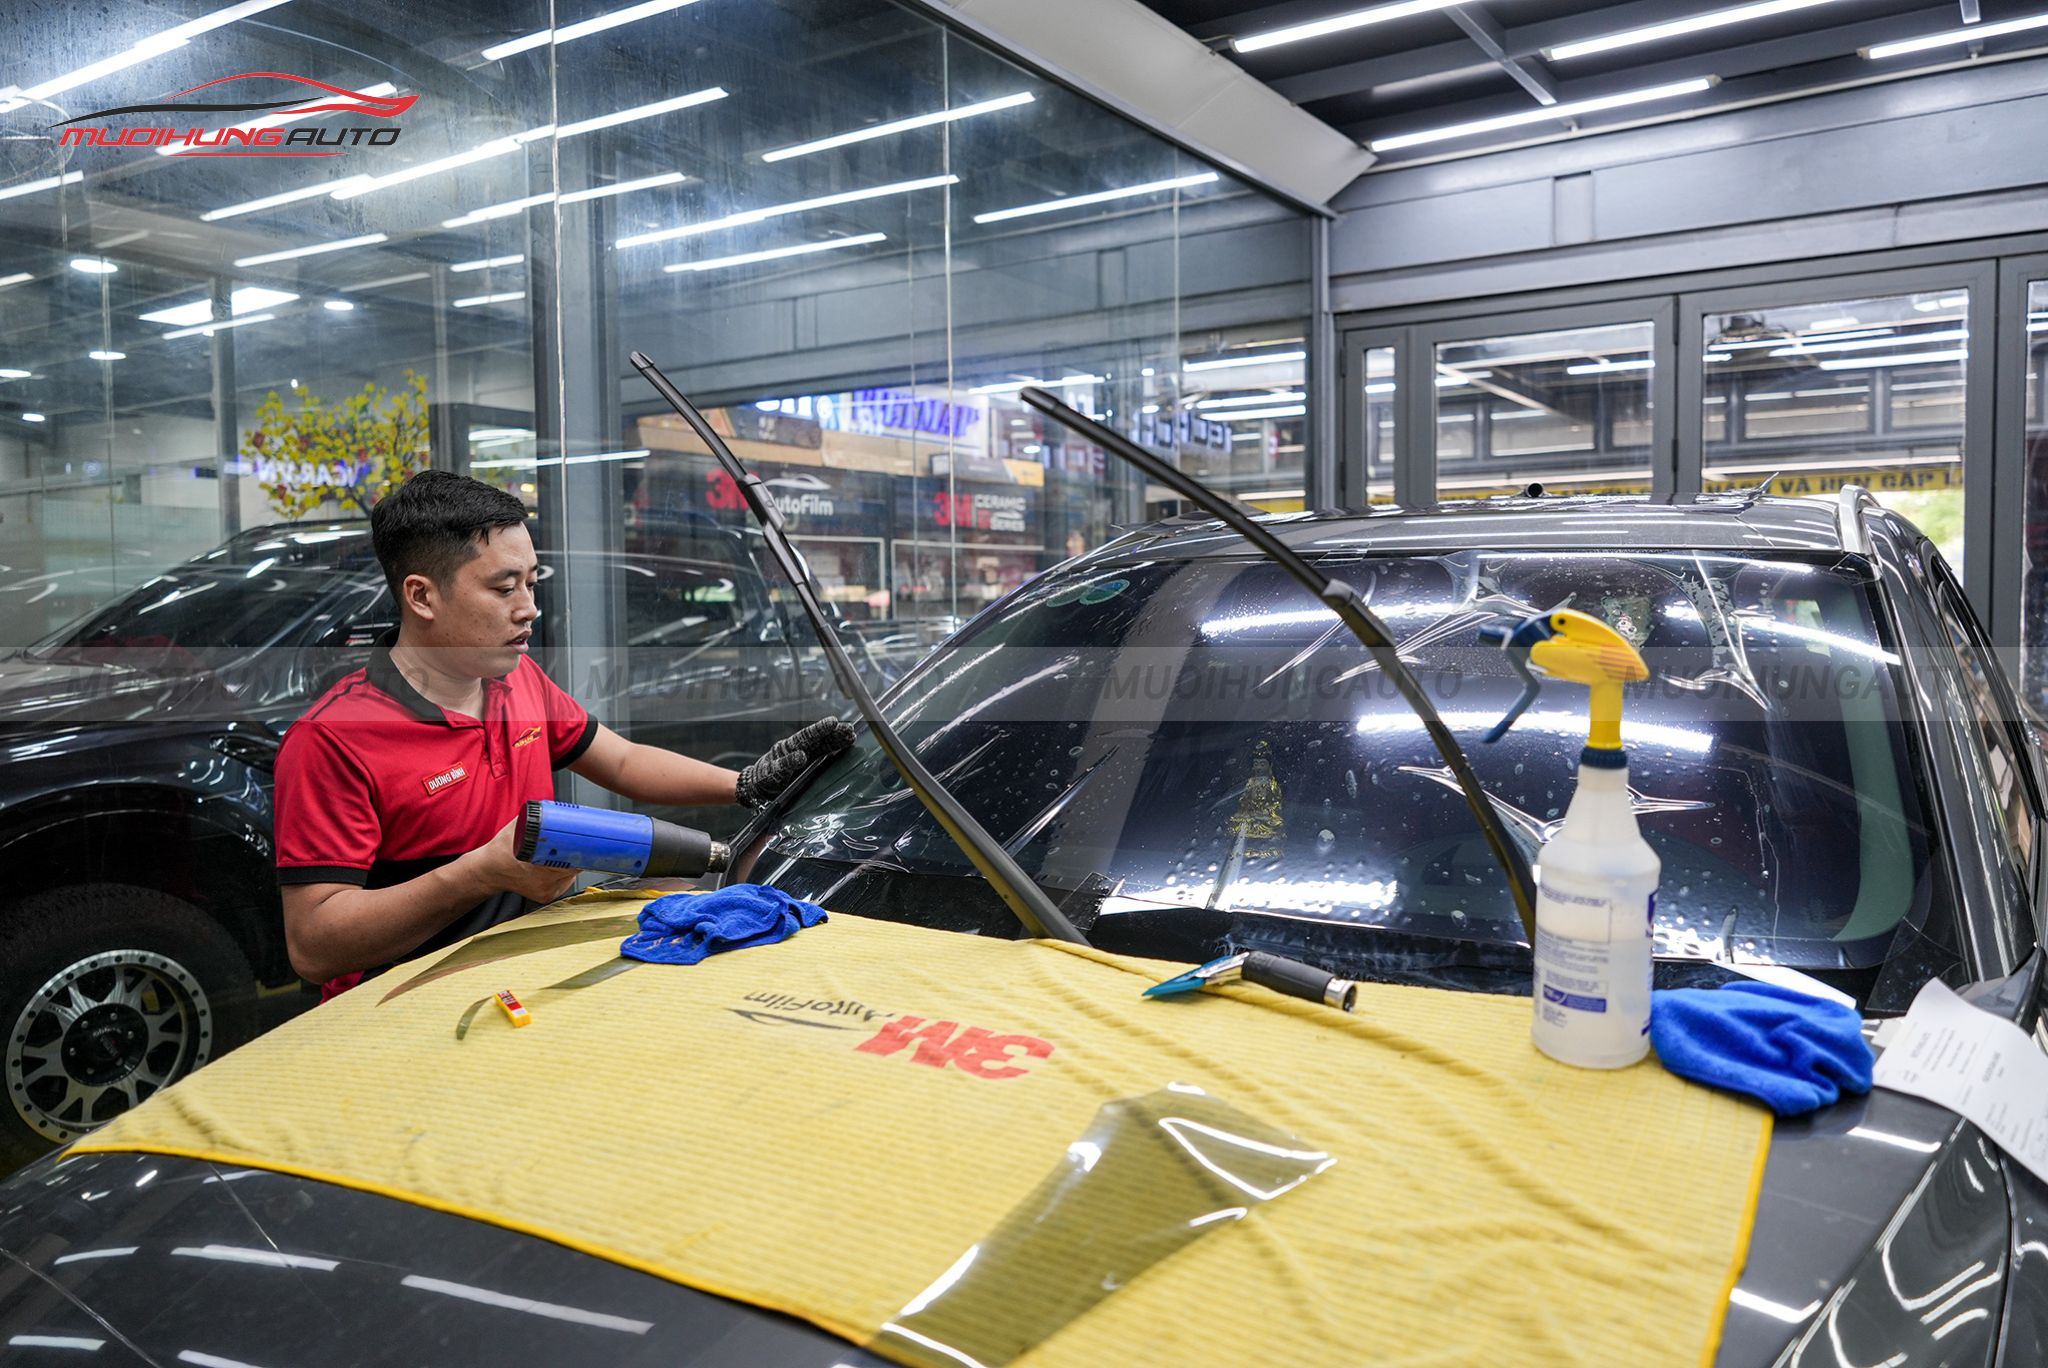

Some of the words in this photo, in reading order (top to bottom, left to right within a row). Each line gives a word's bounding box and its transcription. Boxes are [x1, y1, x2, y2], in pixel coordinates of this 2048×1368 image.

[772, 493, 834, 516] utoFilm
[933, 491, 973, 528] 3M
[743, 991, 895, 1022] AutoFilm
[854, 1015, 1056, 1079] 3M
